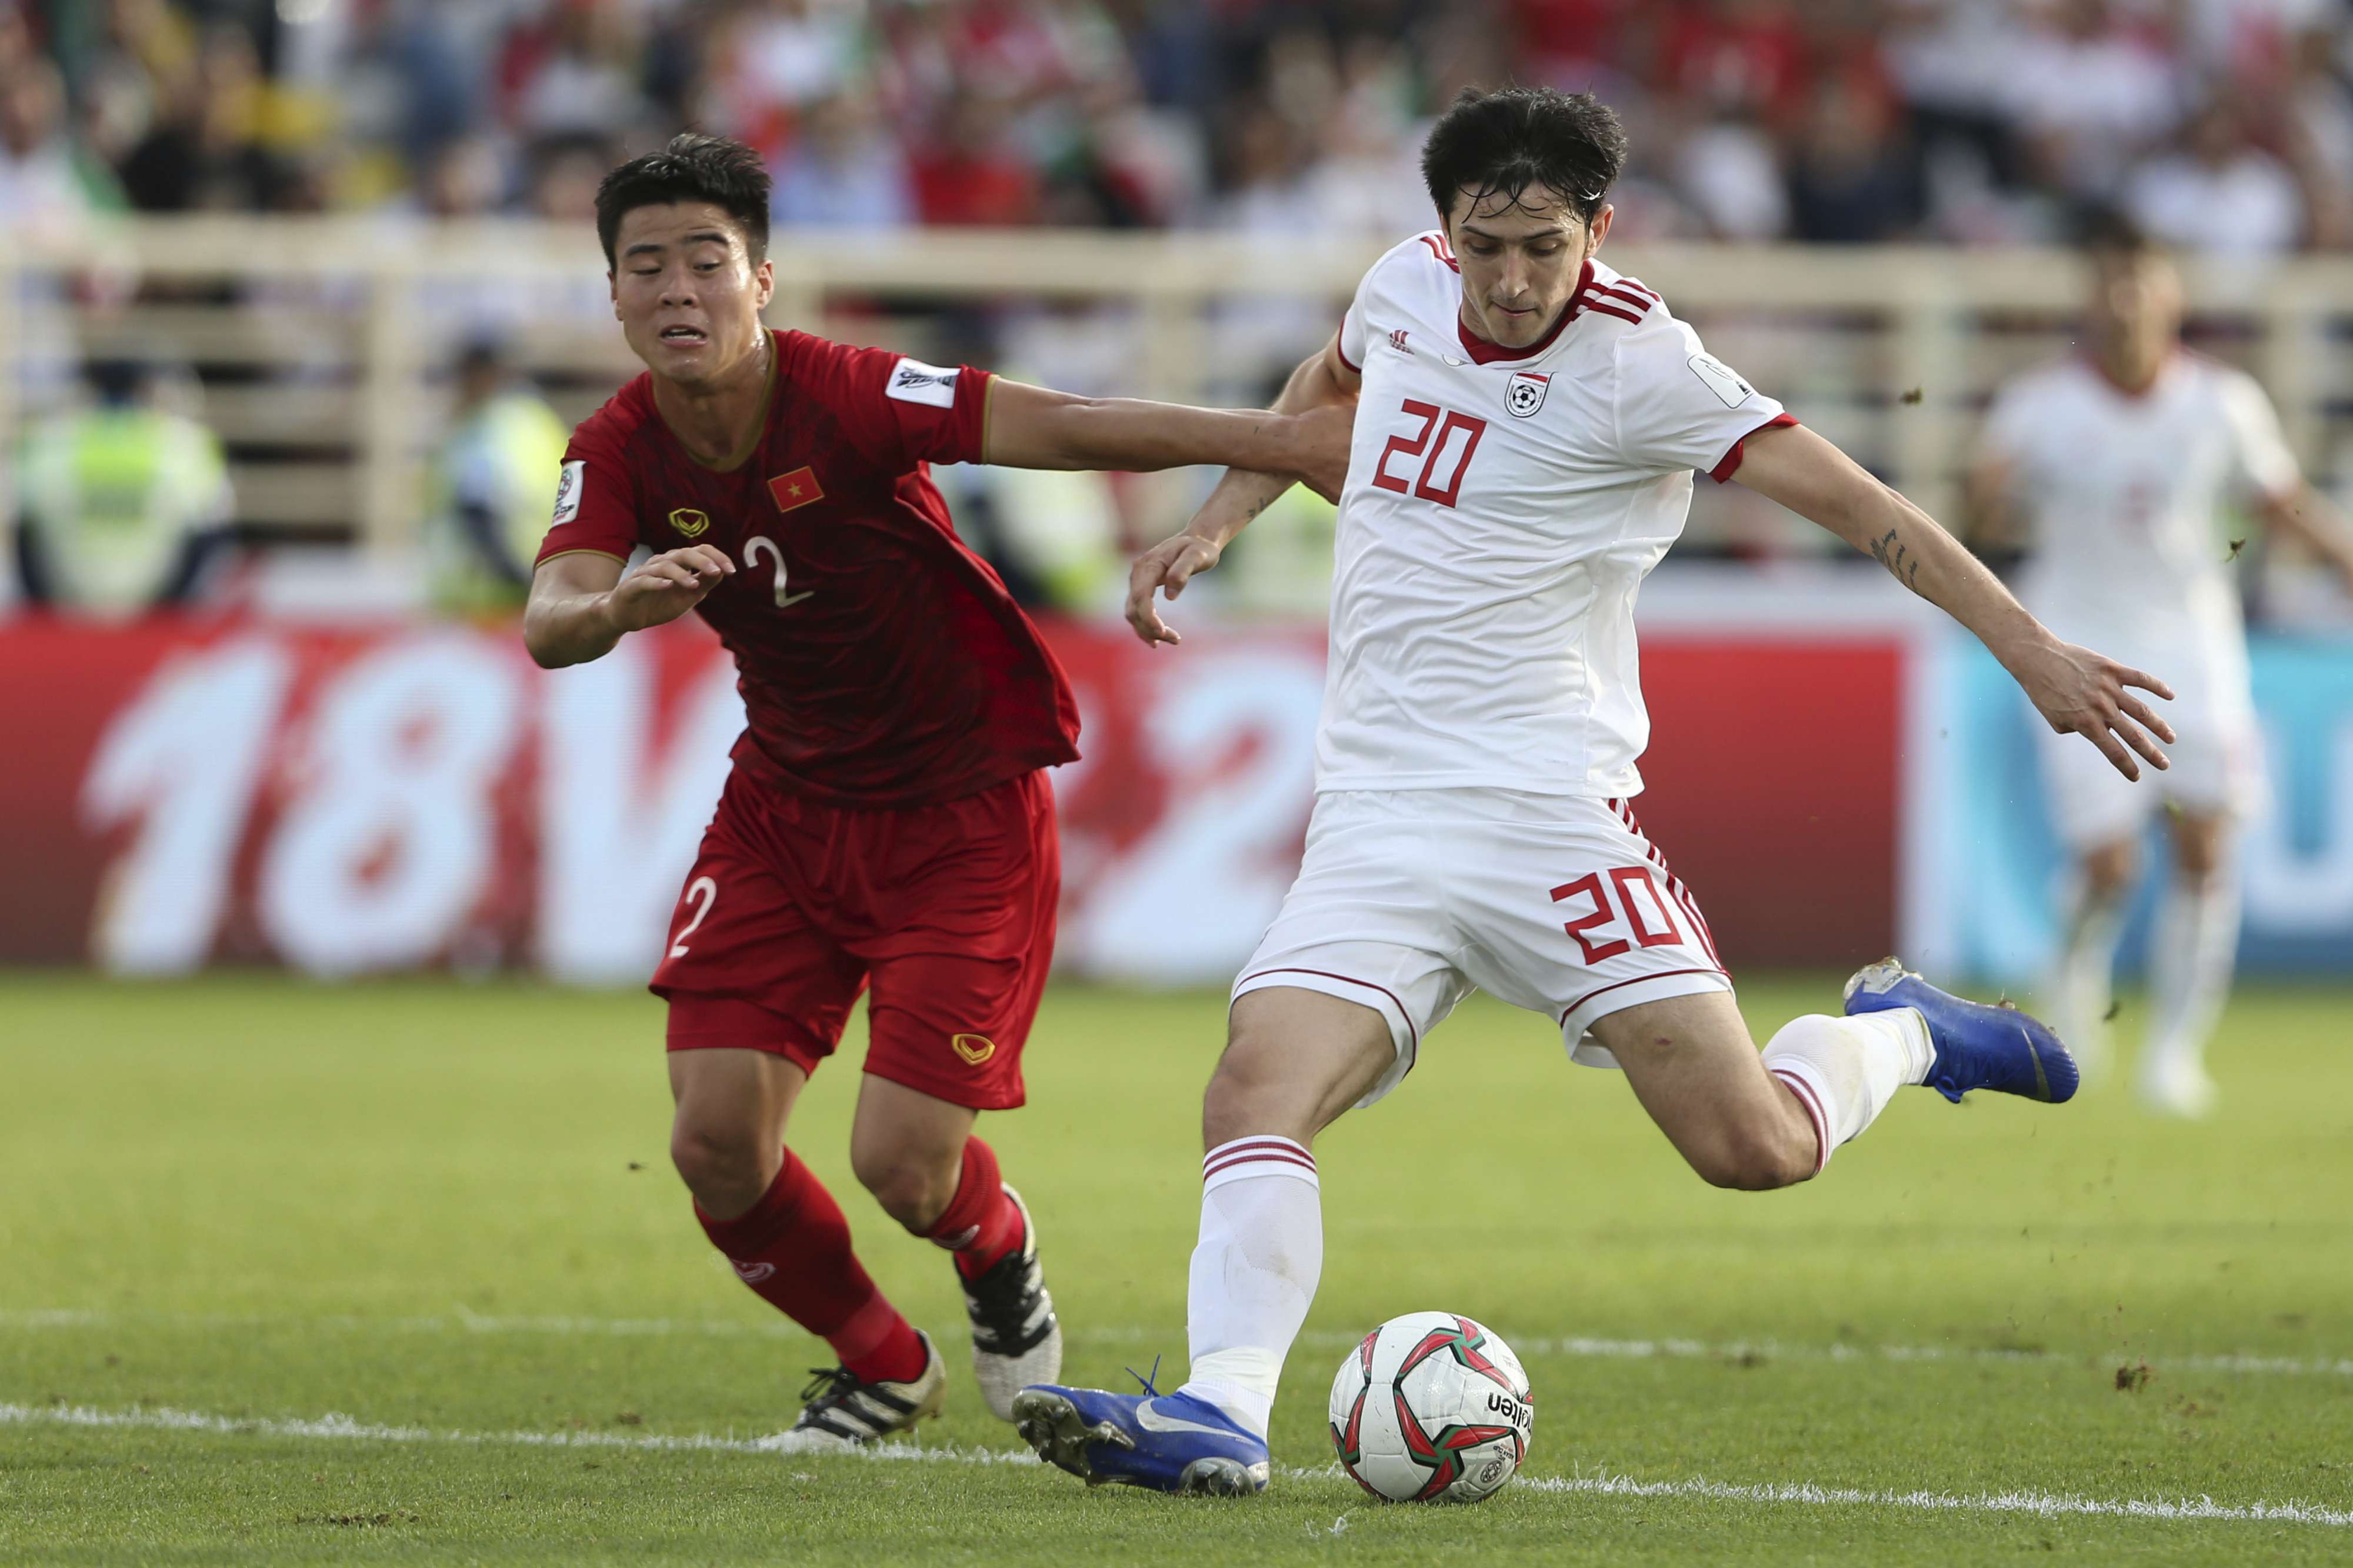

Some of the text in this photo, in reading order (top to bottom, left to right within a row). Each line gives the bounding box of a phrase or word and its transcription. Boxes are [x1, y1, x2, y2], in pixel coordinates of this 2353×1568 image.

[1372, 398, 1487, 509] 20
[742, 536, 815, 608] 2
[668, 875, 717, 959] 2
[1548, 866, 1684, 965] 20
